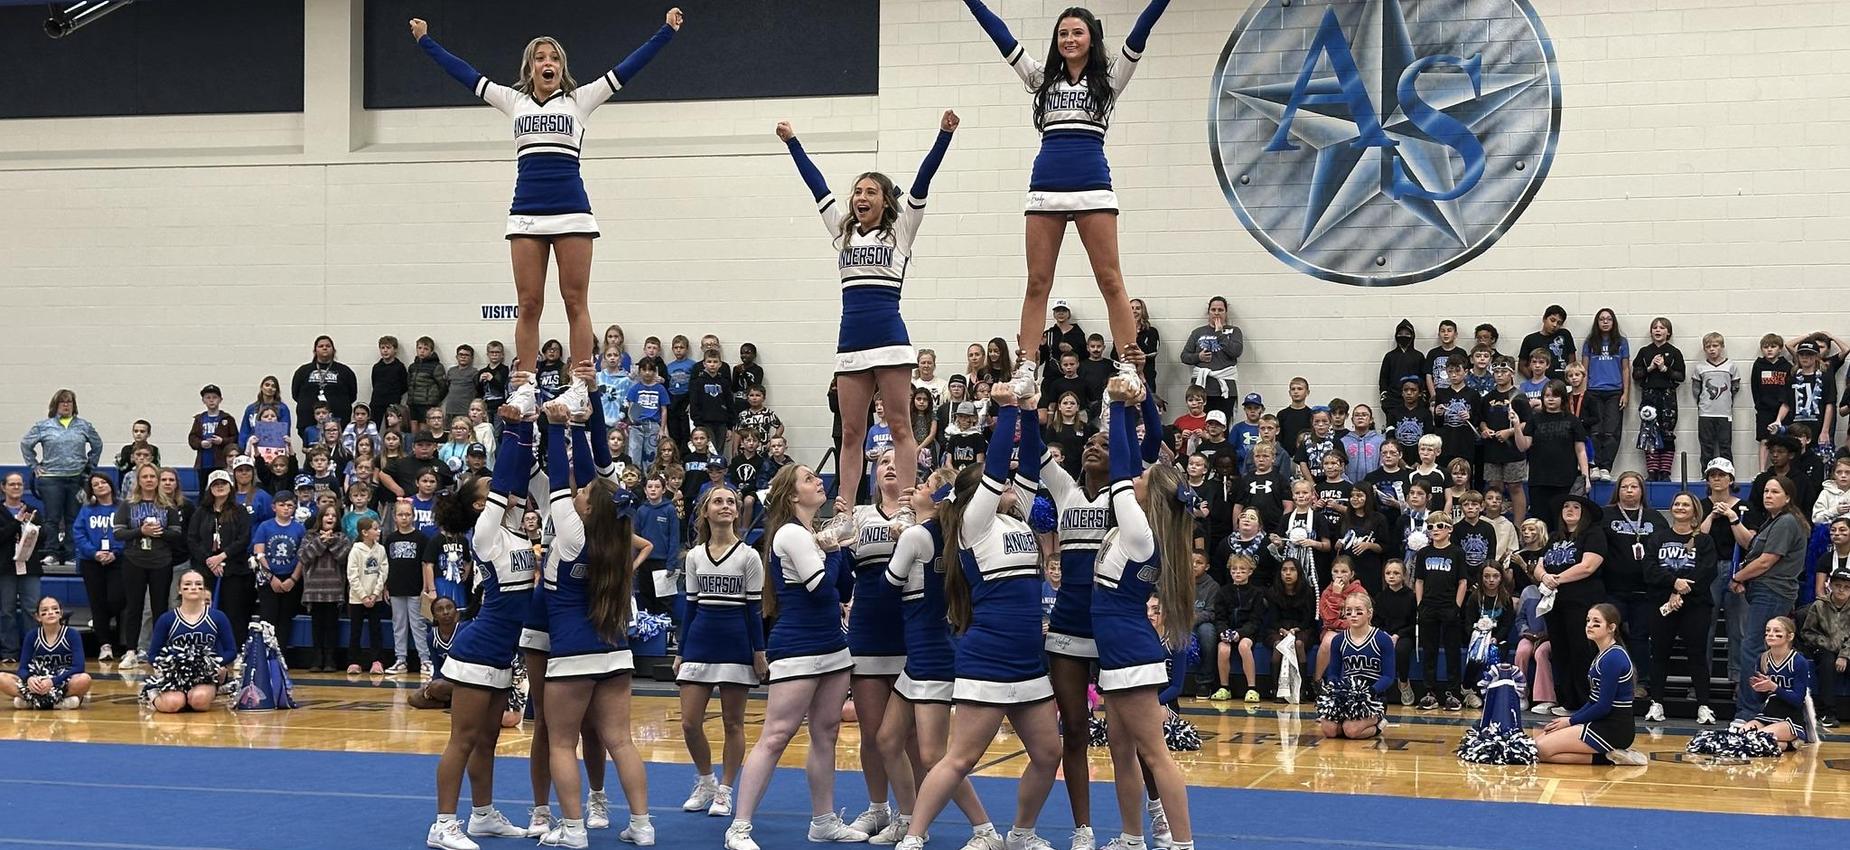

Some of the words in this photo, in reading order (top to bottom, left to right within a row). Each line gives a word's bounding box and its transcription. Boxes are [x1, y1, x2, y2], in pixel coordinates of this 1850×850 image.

[514, 115, 575, 139] NDERSON
[838, 246, 894, 270] NDERSON
[541, 375, 559, 386] WLS
[1320, 489, 1342, 499] OWLS
[443, 543, 463, 552] OWLS
[1658, 546, 1697, 560] OWLS
[1424, 556, 1453, 572] OWLS
[696, 573, 746, 595] NDERSON
